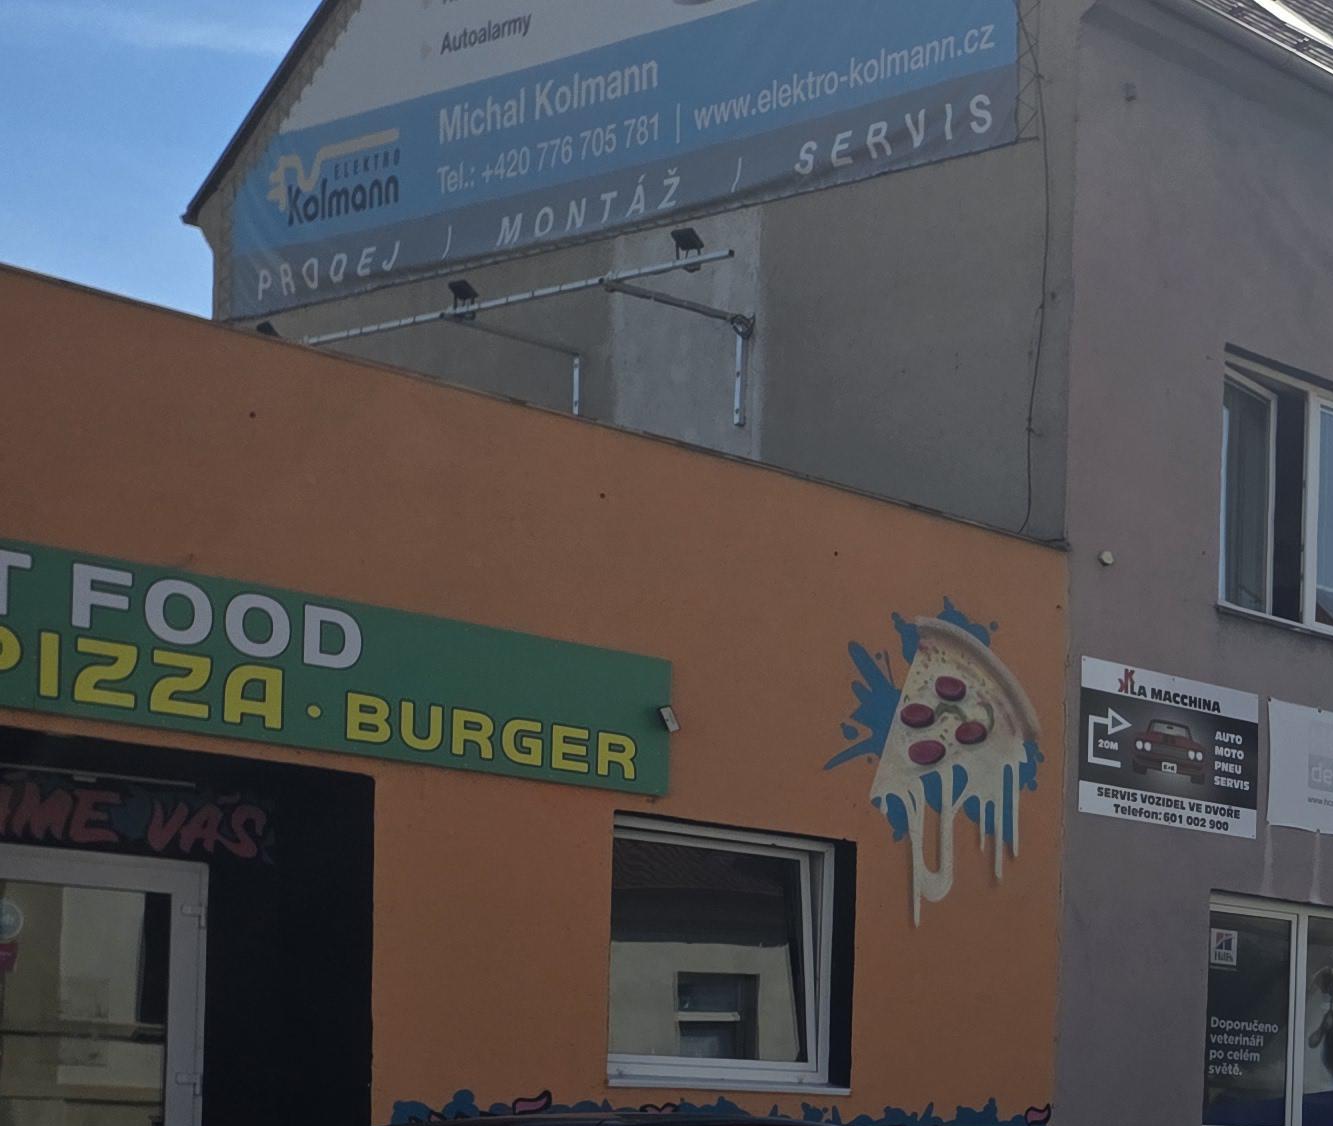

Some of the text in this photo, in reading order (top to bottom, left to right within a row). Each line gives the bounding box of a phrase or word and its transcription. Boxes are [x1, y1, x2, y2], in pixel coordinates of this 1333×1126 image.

[440, 13, 532, 55] Autoalarmy
[437, 162, 475, 194] Tel.:
[481, 146, 530, 184] +420
[536, 135, 573, 175] 776
[580, 123, 616, 160] 705
[623, 111, 659, 148] 781
[693, 24, 995, 131] www.elektro-kolmann.cz
[439, 60, 658, 144] Michal Kolmann
[334, 148, 400, 180] ELEKTRO
[258, 240, 400, 300] PRODEJ
[496, 169, 681, 247] MONTÁŽ
[795, 94, 992, 176] SERVIS
[287, 175, 400, 227] Kolmann
[71, 561, 363, 670] FOOD
[1150, 687, 1221, 714] MACCHINA
[345, 691, 638, 780] BURGER
[1098, 739, 1119, 751] 20M
[1214, 731, 1243, 745] AUTO
[1214, 745, 1245, 760] MOTO
[1214, 761, 1242, 775] PNEU
[1213, 776, 1250, 791] SERVIS
[1097, 786, 1138, 802] SERVIS
[1140, 793, 1186, 810] VOZIDEL
[1188, 801, 1202, 813] VE
[147, 791, 267, 858] VÁS
[1113, 803, 1229, 831] Telefon: 601 002 900
[1210, 1016, 1278, 1034] Doporučeno
[1209, 1048, 1260, 1063] po celém
